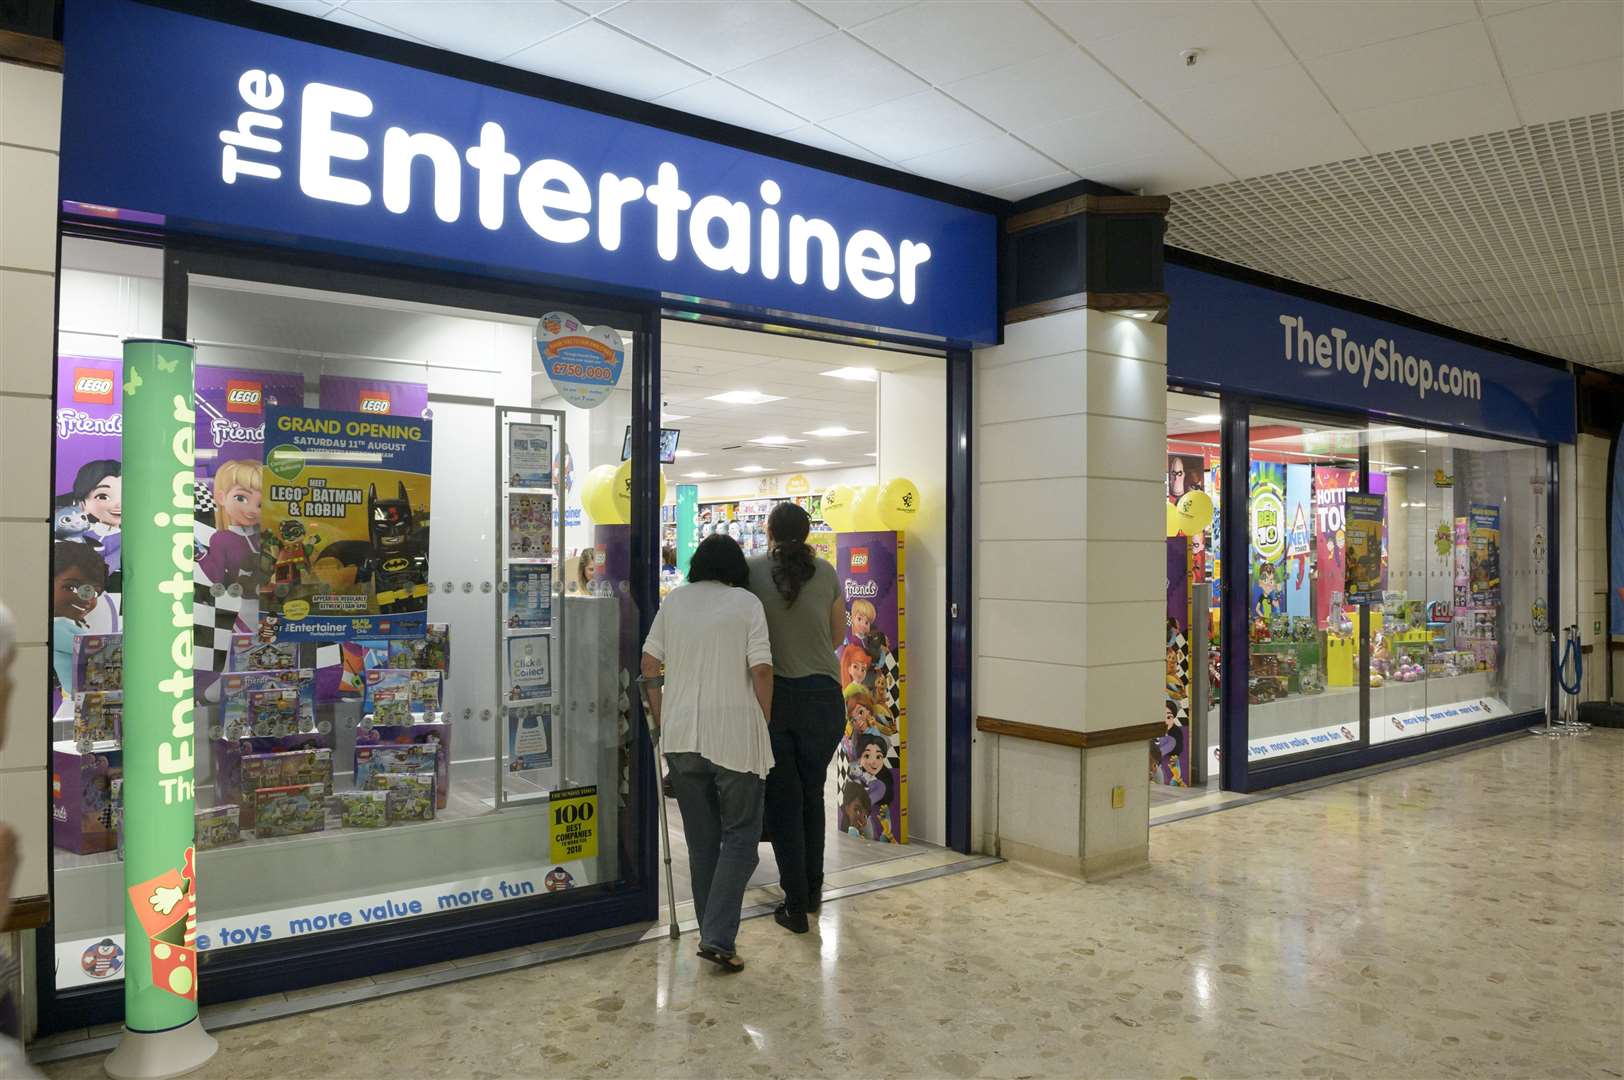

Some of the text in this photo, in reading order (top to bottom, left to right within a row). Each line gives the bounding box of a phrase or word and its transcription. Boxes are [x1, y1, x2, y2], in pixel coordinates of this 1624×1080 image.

[219, 69, 931, 305] The Entertainer
[1279, 314, 1481, 400] TheToyShop.com
[75, 376, 112, 394] LEGO
[227, 389, 260, 405] LEGO
[361, 399, 389, 412] LEGO
[211, 417, 265, 447] Friend
[277, 415, 422, 441] GRAND OPENING
[293, 436, 347, 448] SATURDAY
[367, 441, 407, 452] AUGUST
[309, 479, 326, 488] MEET
[312, 489, 362, 504] BATMAN
[289, 501, 345, 517] & ROBIN
[1257, 510, 1278, 529] BEN
[1257, 526, 1279, 546] 10
[851, 555, 868, 568] LEGO
[290, 622, 347, 633] Entertainer
[554, 802, 594, 825] 100
[555, 829, 592, 842] COMPANIES
[566, 823, 581, 832] BEST
[219, 921, 272, 947] toys
[289, 910, 353, 935] more
[359, 897, 422, 923] value
[437, 887, 494, 910] more
[499, 878, 535, 898] fun
